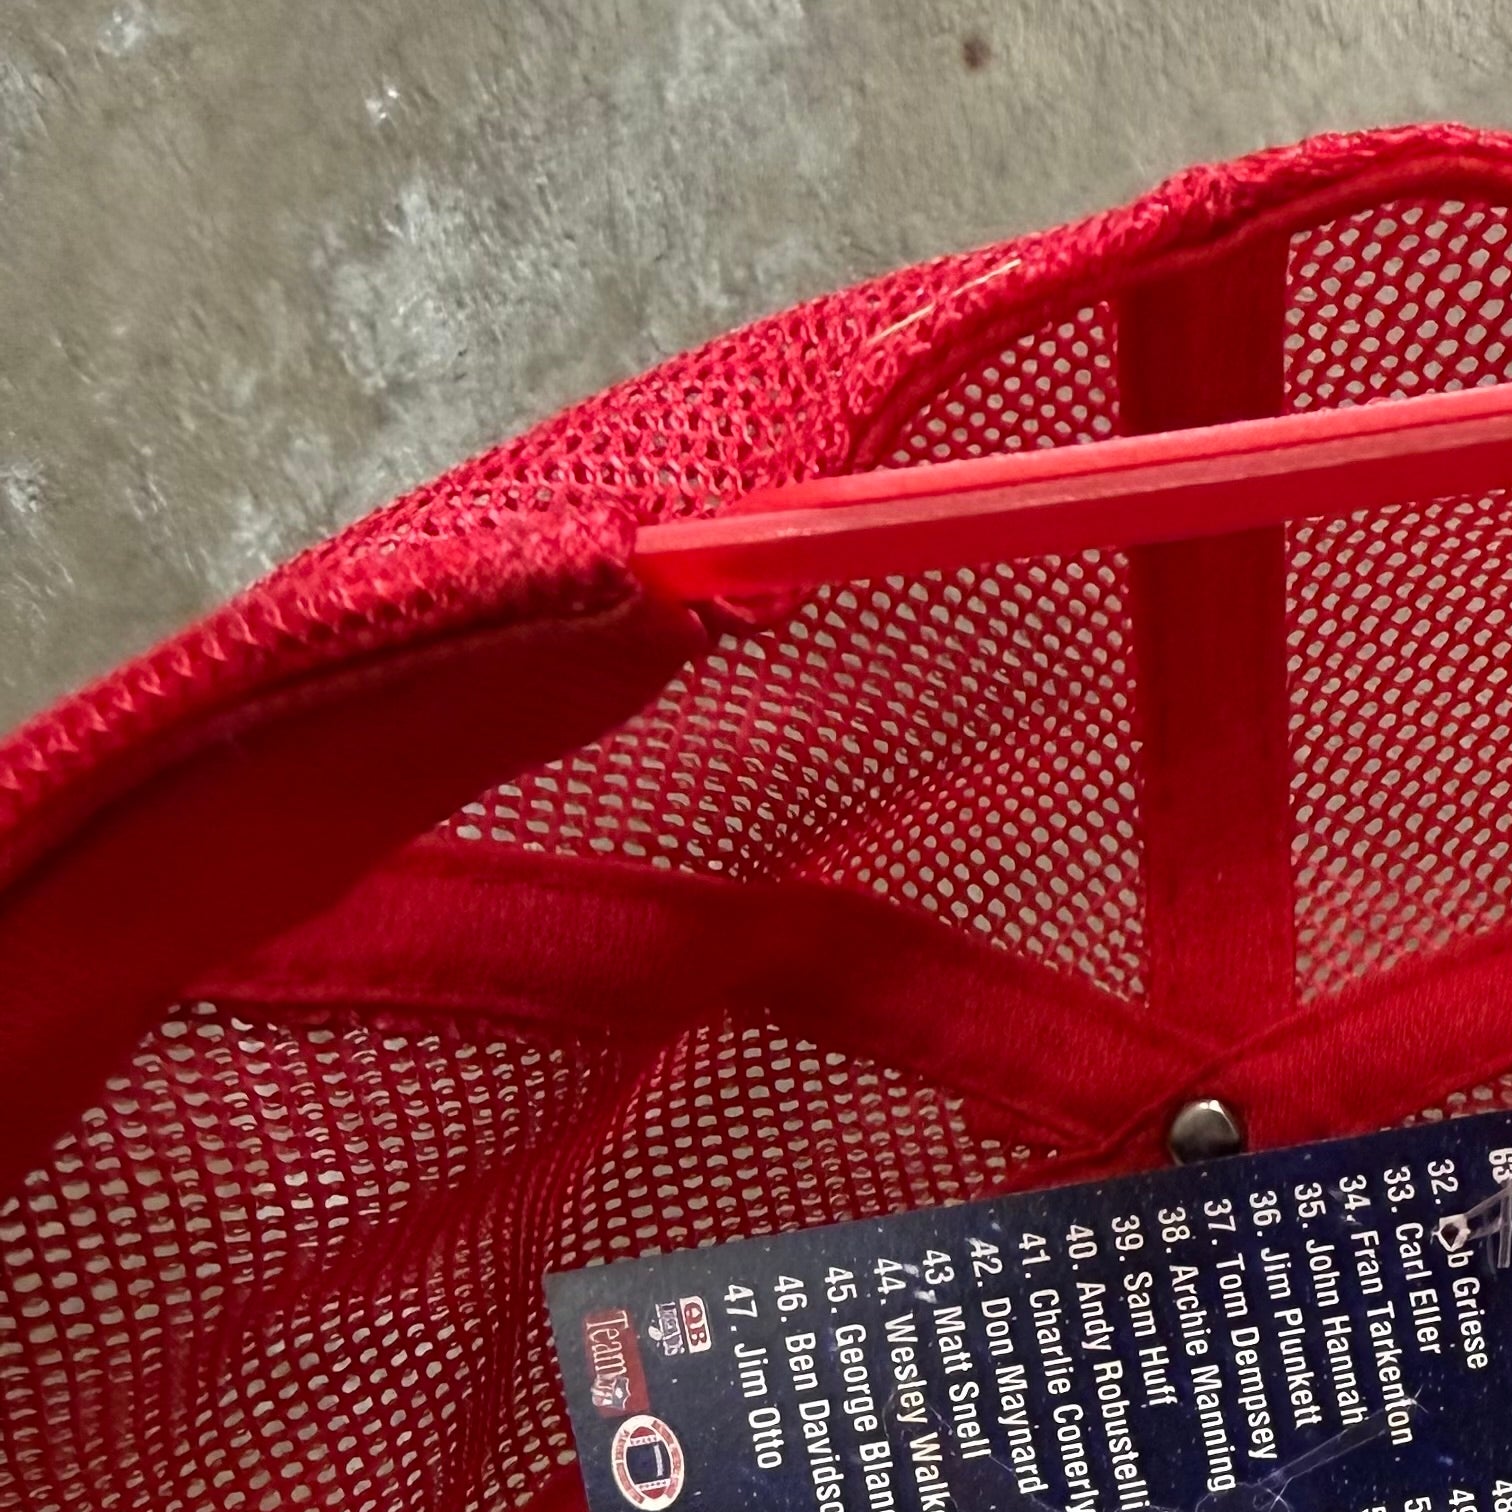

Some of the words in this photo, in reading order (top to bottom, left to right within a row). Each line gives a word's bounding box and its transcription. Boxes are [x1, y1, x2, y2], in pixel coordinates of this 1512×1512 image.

[1248, 1189, 1282, 1237] 36.
[1293, 1181, 1327, 1229] 35.
[1338, 1173, 1371, 1222] 34.
[1382, 1165, 1415, 1213] 33.
[1064, 1223, 1098, 1270] 40.
[1110, 1213, 1144, 1262] 39.
[1156, 1205, 1191, 1254] 38.
[1202, 1197, 1237, 1246] 37.
[1394, 1221, 1433, 1281] Carl
[872, 1257, 907, 1305] 44.
[921, 1248, 955, 1298] 43.
[969, 1240, 1003, 1288] 42.
[1017, 1232, 1051, 1279] 41.
[1215, 1251, 1248, 1318] Tom
[1259, 1246, 1291, 1300] Jim
[1304, 1238, 1340, 1307] John
[1349, 1229, 1383, 1295] Fran
[1426, 1157, 1459, 1205] 32.
[1451, 1276, 1488, 1369] Griese
[722, 1283, 758, 1332] 47.
[772, 1274, 808, 1323] 46.
[823, 1265, 858, 1314] 45.
[1075, 1281, 1115, 1351] Andy
[1122, 1270, 1157, 1337] Sam
[1168, 1264, 1209, 1356] Archie
[1408, 1287, 1442, 1354] Eller
[586, 1310, 628, 1378] Team
[932, 1304, 973, 1374] Matt
[980, 1296, 1014, 1356] Don
[1028, 1287, 1073, 1395] Charlie
[733, 1342, 769, 1398] Jim
[784, 1331, 818, 1391] Ben
[834, 1323, 878, 1432] George
[883, 1312, 928, 1423] Wesley
[1137, 1344, 1178, 1406] Huff
[1229, 1325, 1278, 1459] Dempsey
[1272, 1306, 1322, 1429] Plunkett
[1321, 1314, 1368, 1425] Hannah
[1365, 1299, 1414, 1445] Tarkenton
[747, 1406, 784, 1469] Otto
[947, 1380, 992, 1459] Snell
[994, 1363, 1049, 1494] Maynard
[1092, 1359, 1151, 1511] Robustelli
[1189, 1363, 1237, 1492] Manning
